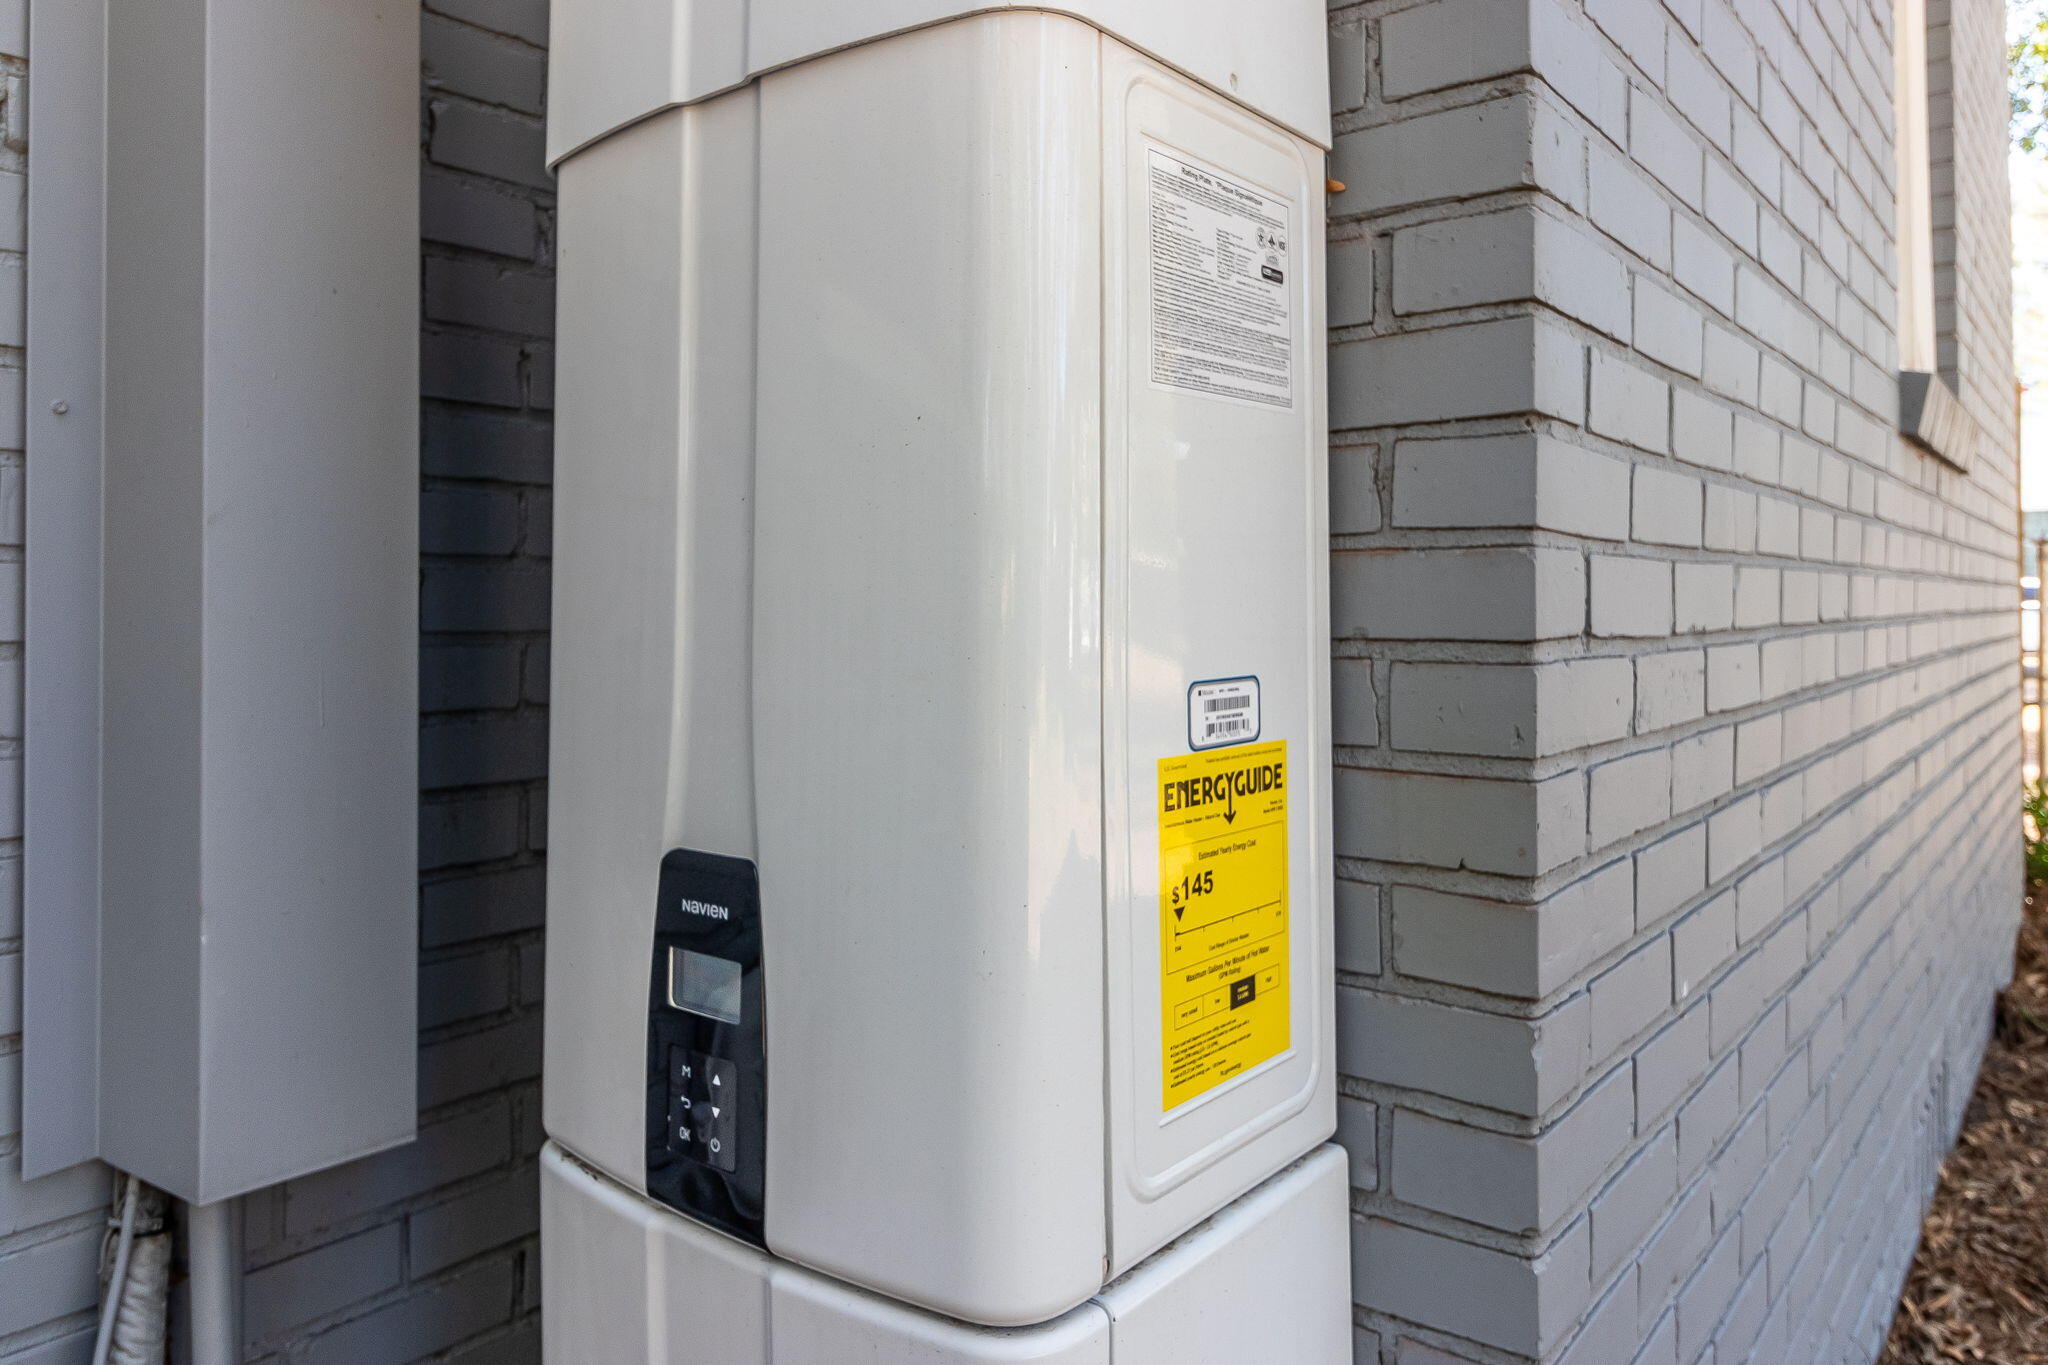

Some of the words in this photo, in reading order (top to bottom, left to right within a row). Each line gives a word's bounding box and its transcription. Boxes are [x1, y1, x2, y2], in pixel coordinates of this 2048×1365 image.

[1164, 763, 1283, 812] ENERGYGUIDE
[1172, 870, 1213, 906] $145
[682, 1065, 691, 1078] M
[680, 1126, 691, 1141] OK
